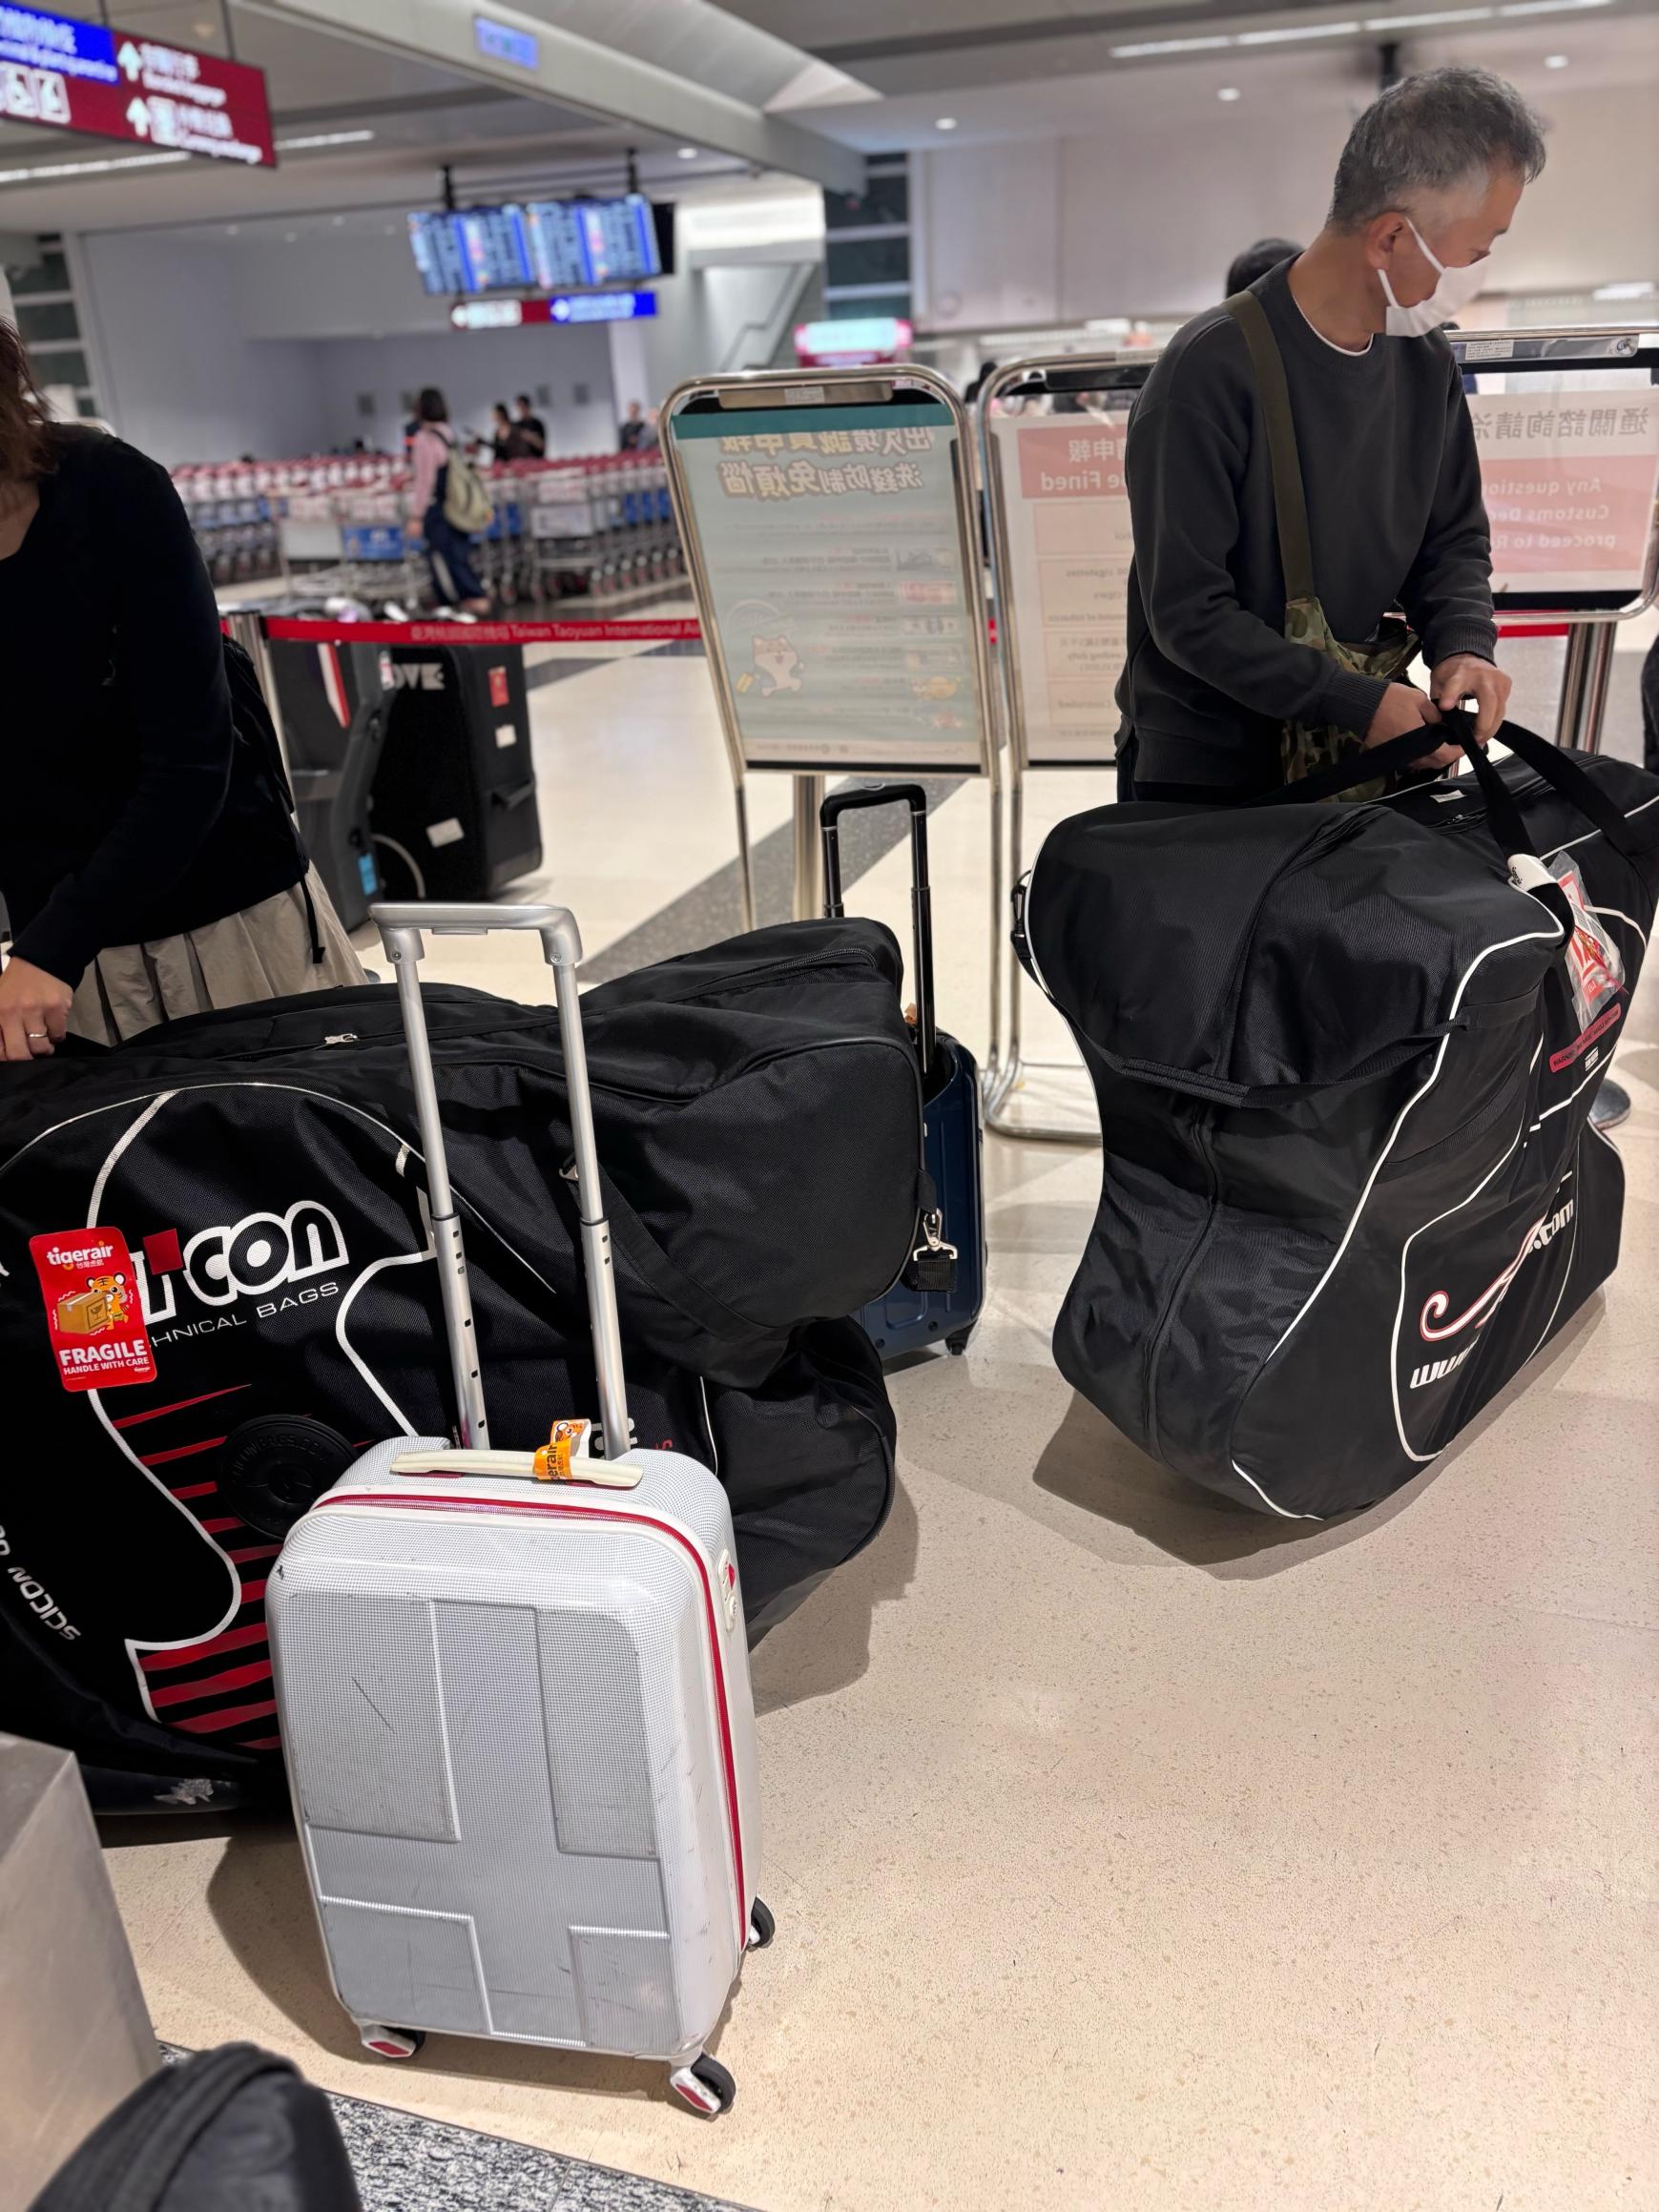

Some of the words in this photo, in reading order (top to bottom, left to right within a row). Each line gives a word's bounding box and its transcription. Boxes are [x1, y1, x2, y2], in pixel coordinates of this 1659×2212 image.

[47, 1241, 114, 1270] tigerair
[151, 1313, 247, 1348] HNICAL
[256, 1282, 340, 1318] BAGS
[59, 1339, 148, 1366] FRAGILE
[63, 1363, 100, 1375] HANDLE
[100, 1360, 125, 1371] WITH
[125, 1357, 150, 1367] CARE
[547, 1444, 558, 1477] erair
[7, 1566, 82, 1641] SCICON
